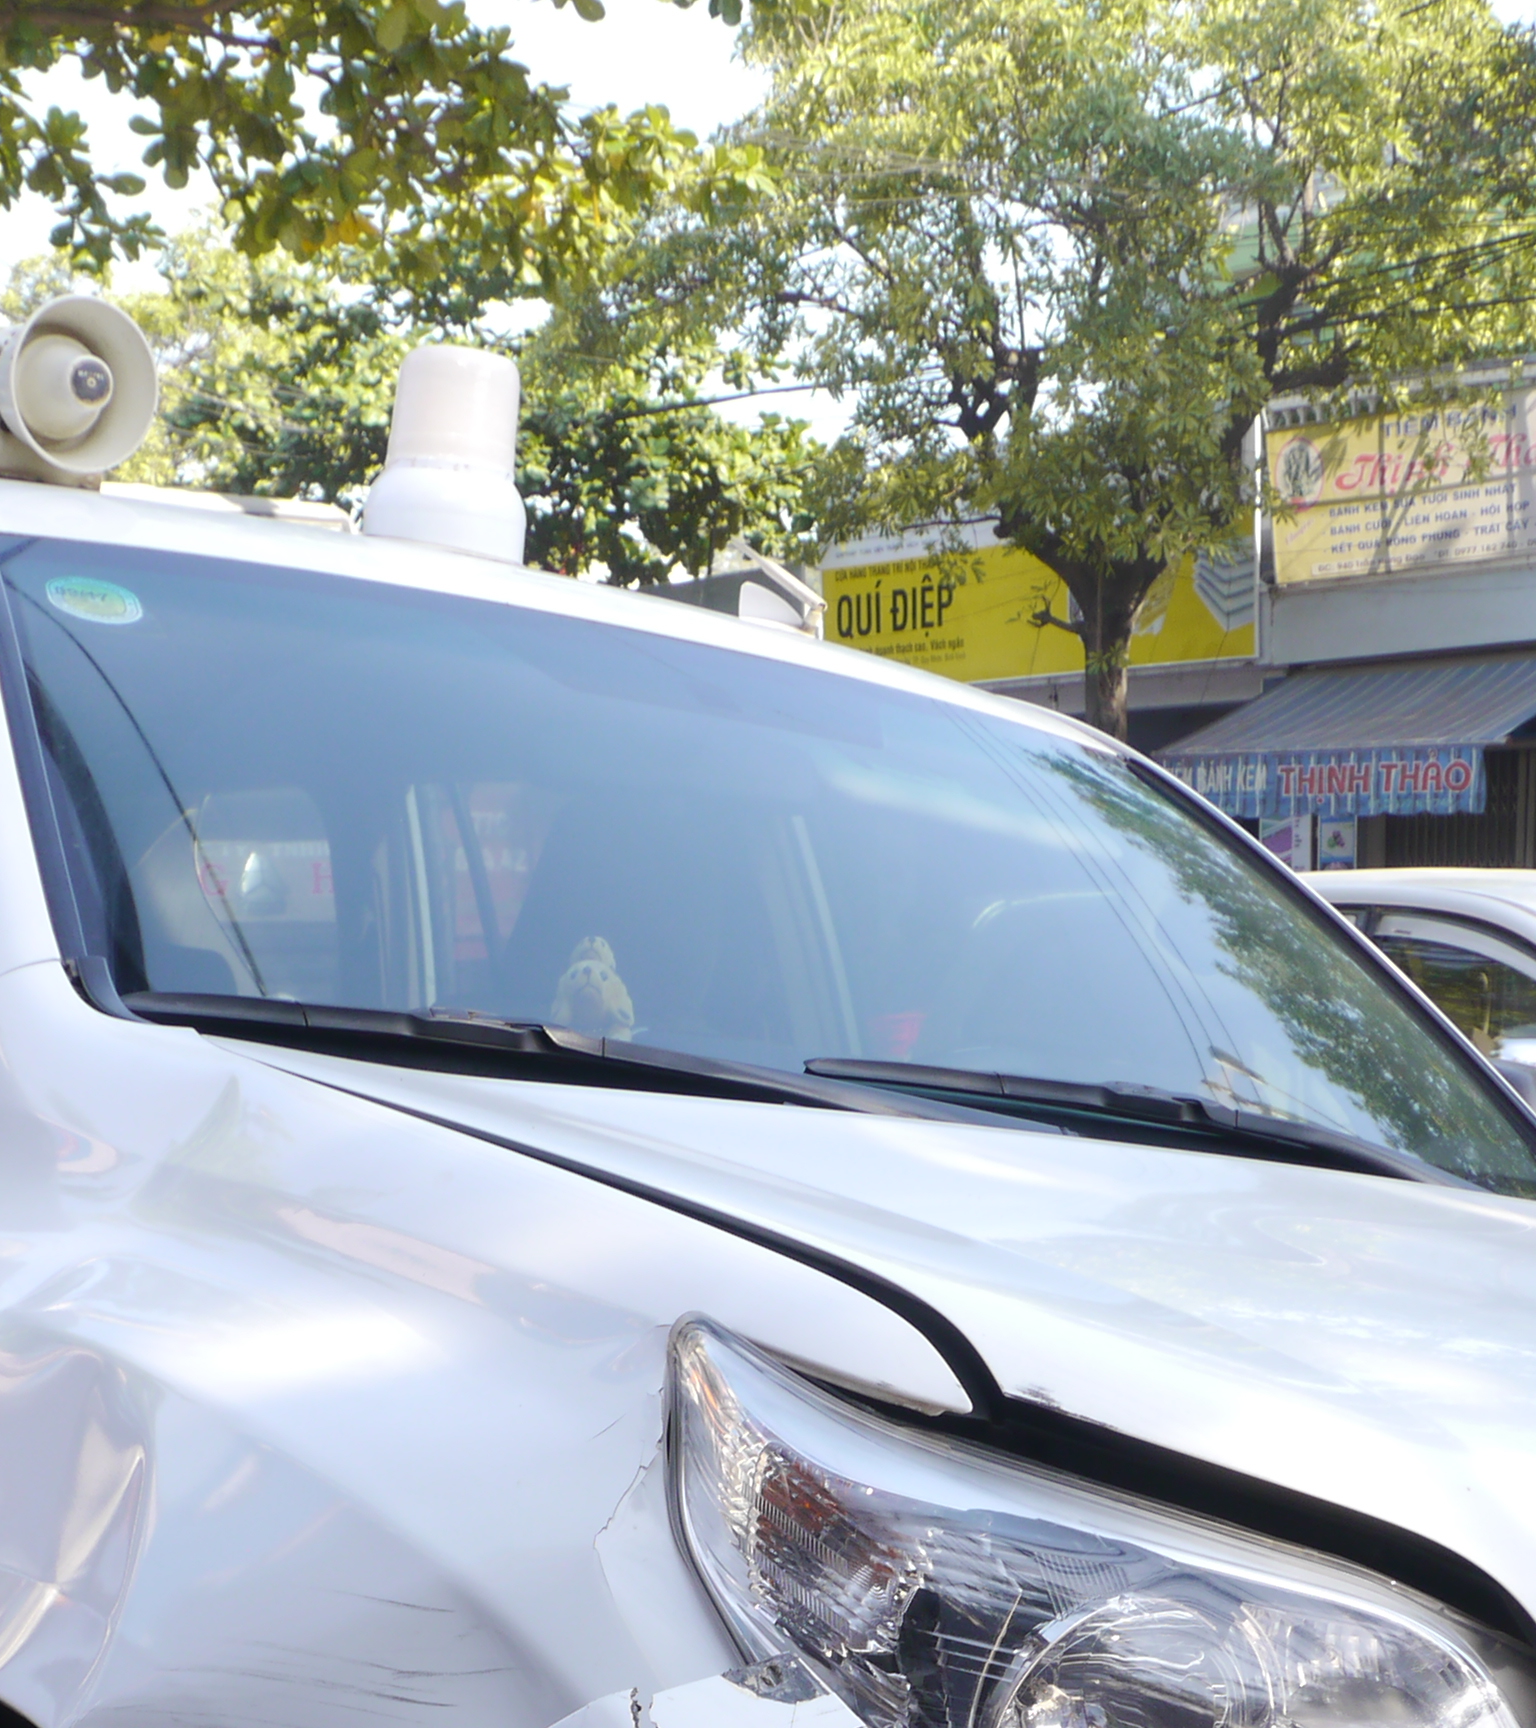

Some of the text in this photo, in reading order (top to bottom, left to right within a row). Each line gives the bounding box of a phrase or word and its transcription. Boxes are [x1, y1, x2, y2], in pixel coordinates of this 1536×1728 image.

[837, 574, 954, 639] QUÍ ĐIỆP
[1279, 761, 1371, 805] THỊNH
[1379, 749, 1473, 793] THẢO
